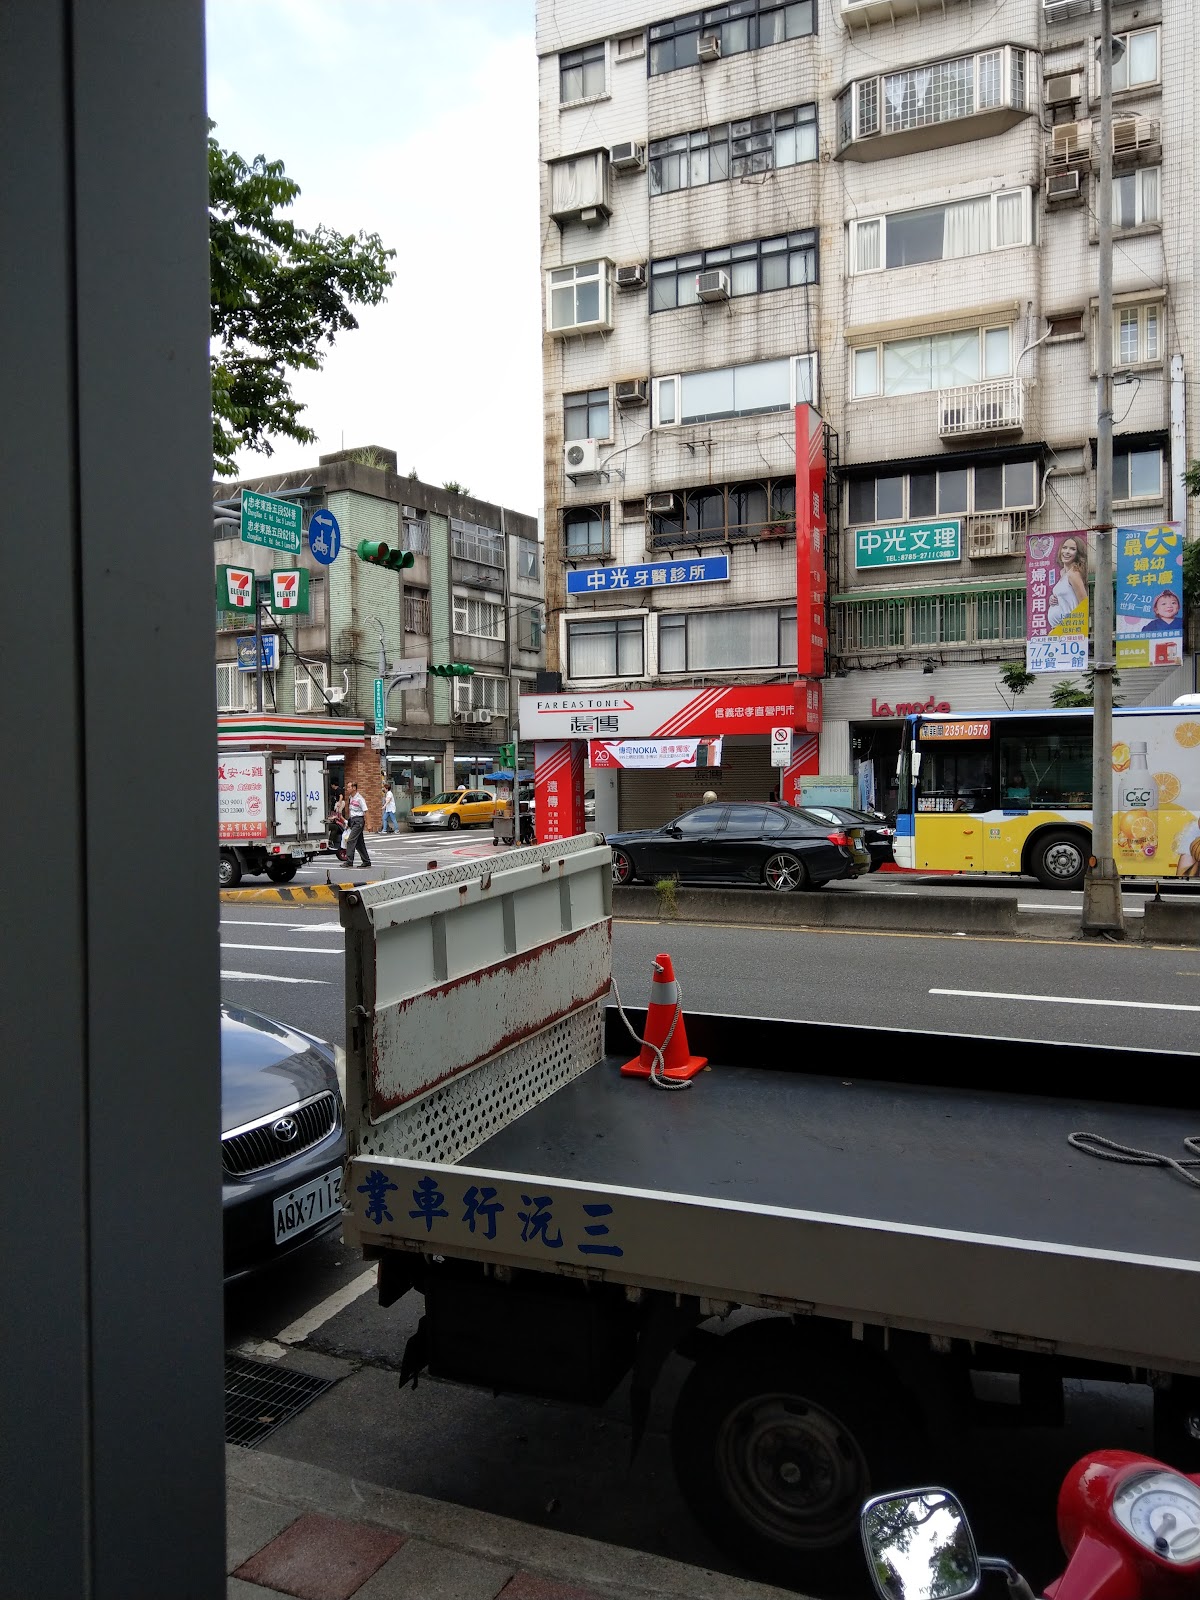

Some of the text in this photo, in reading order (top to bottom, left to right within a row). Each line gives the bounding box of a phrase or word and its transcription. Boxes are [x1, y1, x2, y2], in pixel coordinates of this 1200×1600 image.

[859, 527, 956, 555] 中光文理
[587, 564, 706, 589] 中光牙醫診所
[230, 588, 250, 597] ELEVEN
[1030, 568, 1047, 628] 婦幼用品
[1030, 656, 1084, 670] 世貿一館
[715, 705, 795, 719] 信義忠孝直營門市
[895, 695, 951, 716] mode
[570, 715, 619, 733] 遠傳
[944, 724, 989, 736] 2351-0578
[547, 780, 558, 808] 遠傳
[1125, 791, 1151, 802] C&C
